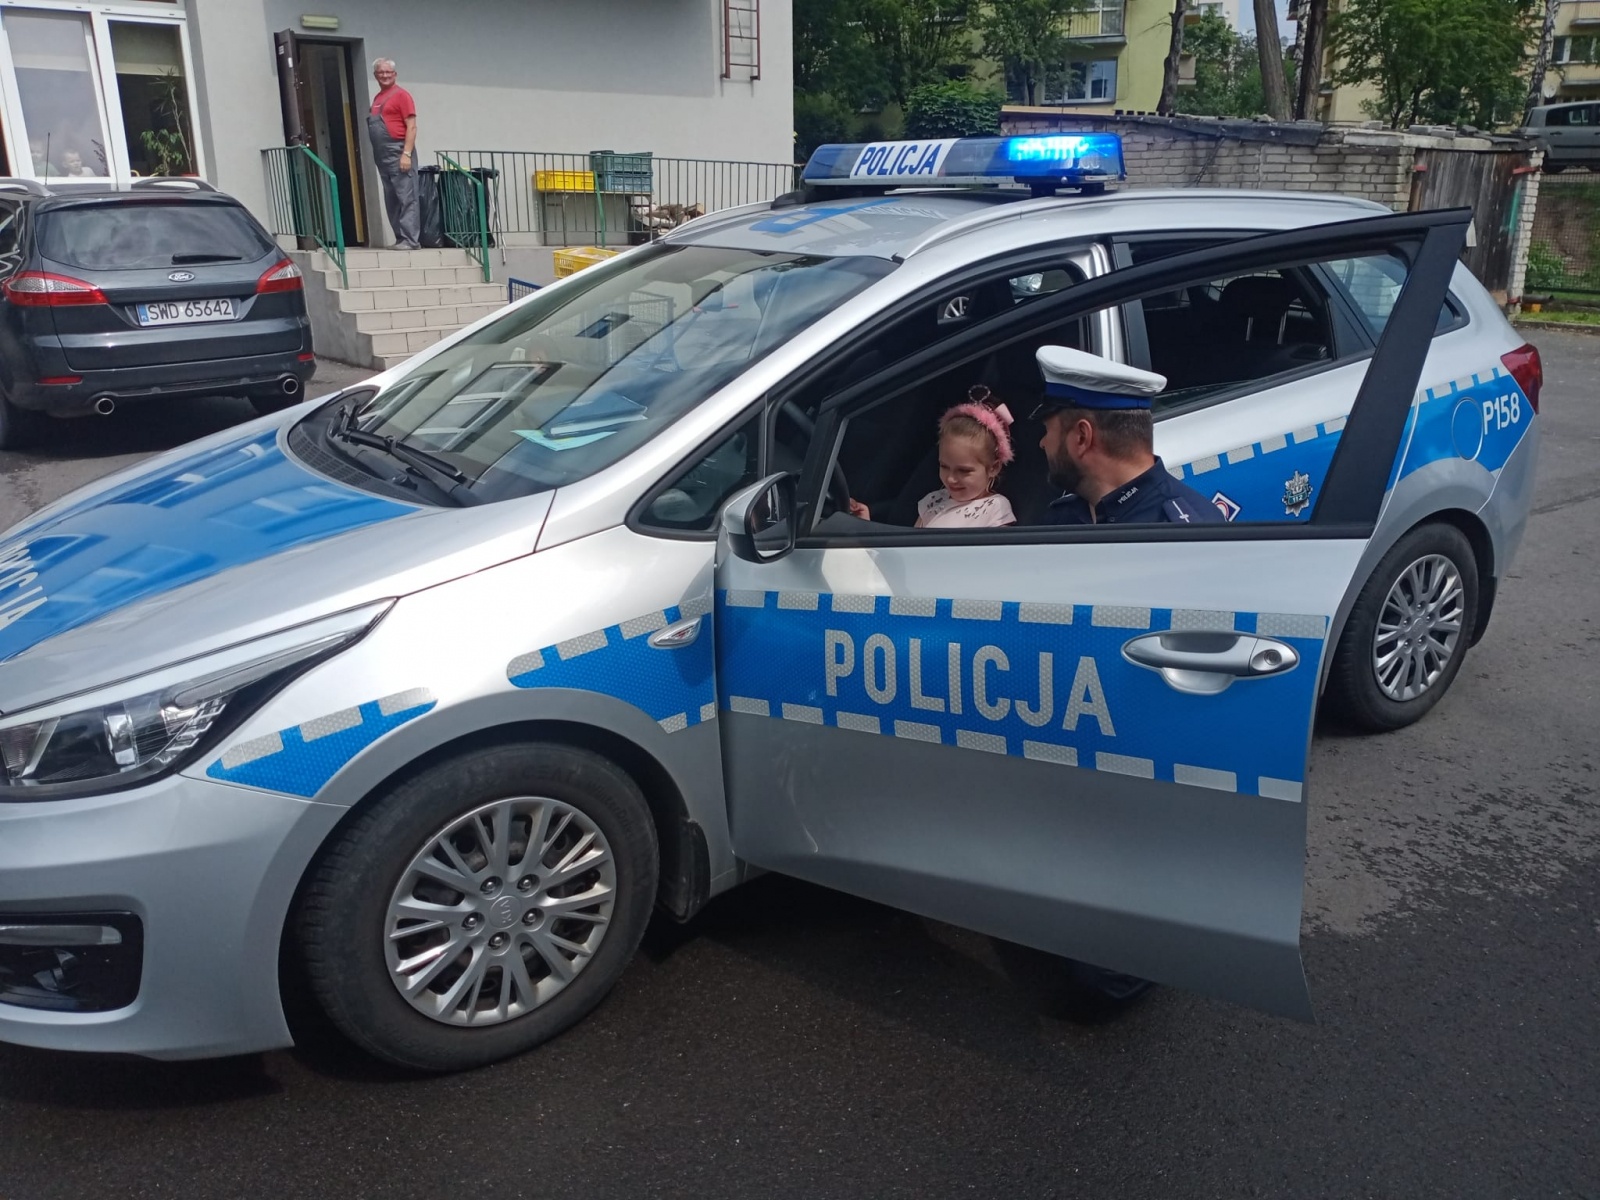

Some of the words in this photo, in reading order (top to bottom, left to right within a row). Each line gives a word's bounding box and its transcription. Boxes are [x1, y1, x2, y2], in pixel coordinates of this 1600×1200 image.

[854, 143, 942, 176] POLICJA
[147, 303, 179, 320] SWD
[184, 300, 231, 318] 65642
[1482, 392, 1520, 435] P158
[1117, 486, 1138, 504] POLICJA
[824, 629, 1117, 737] POLICJA
